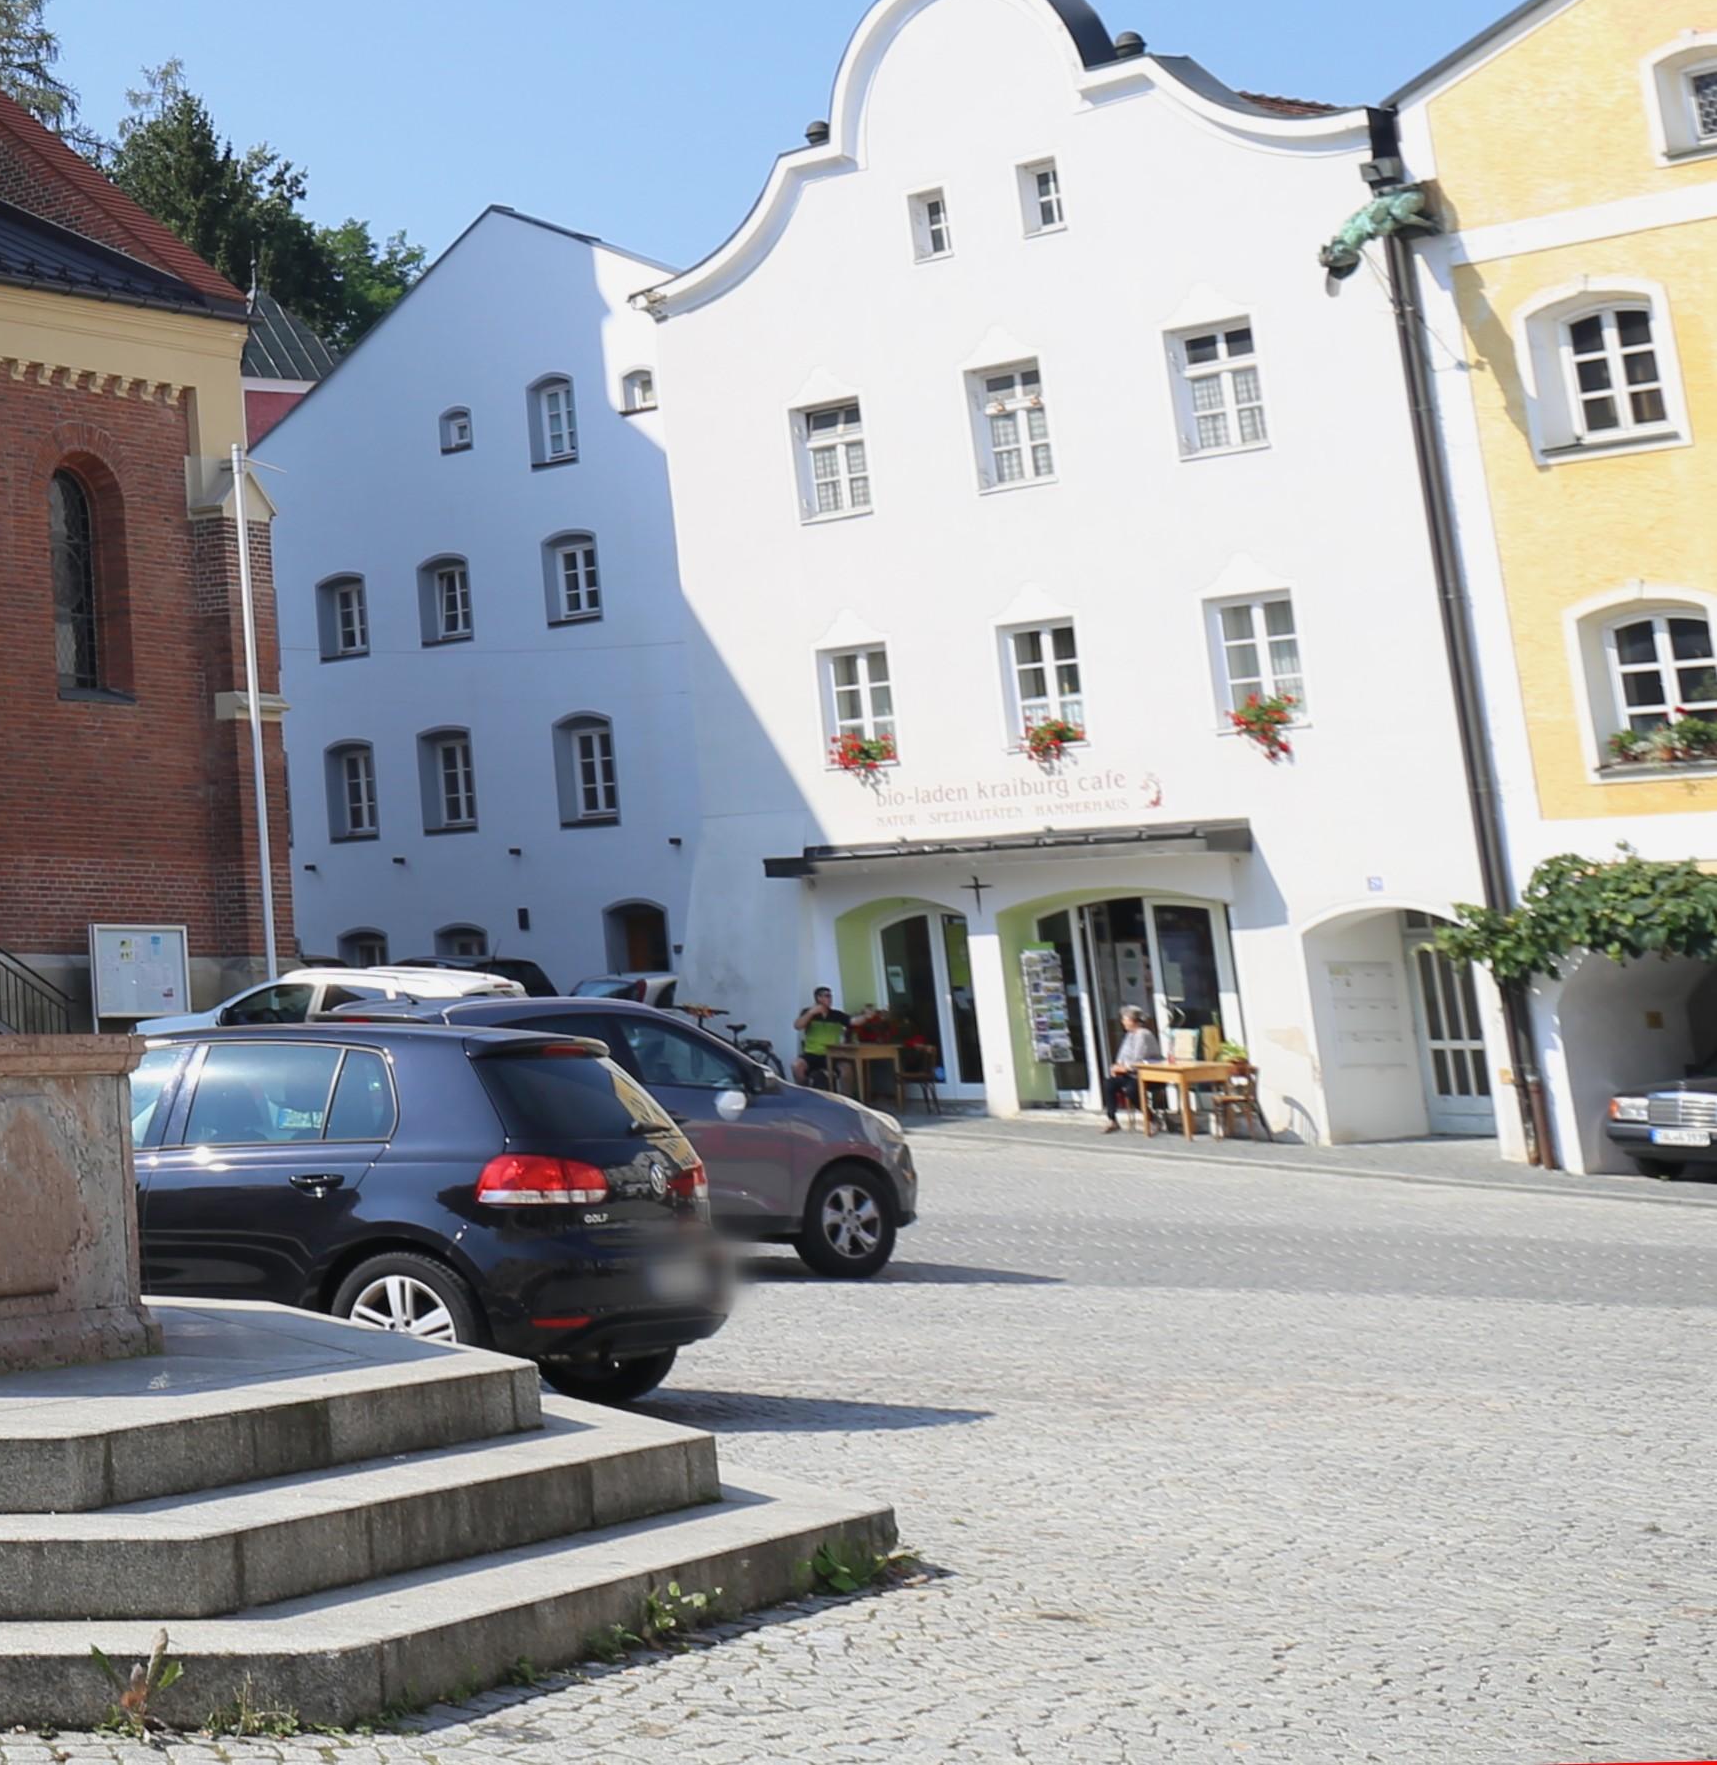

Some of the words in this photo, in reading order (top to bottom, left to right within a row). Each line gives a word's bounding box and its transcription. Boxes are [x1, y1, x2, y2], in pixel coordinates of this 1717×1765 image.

[876, 783, 969, 808] bio-laden
[976, 777, 1070, 801] kraiburg
[584, 1213, 609, 1224] GOLF
